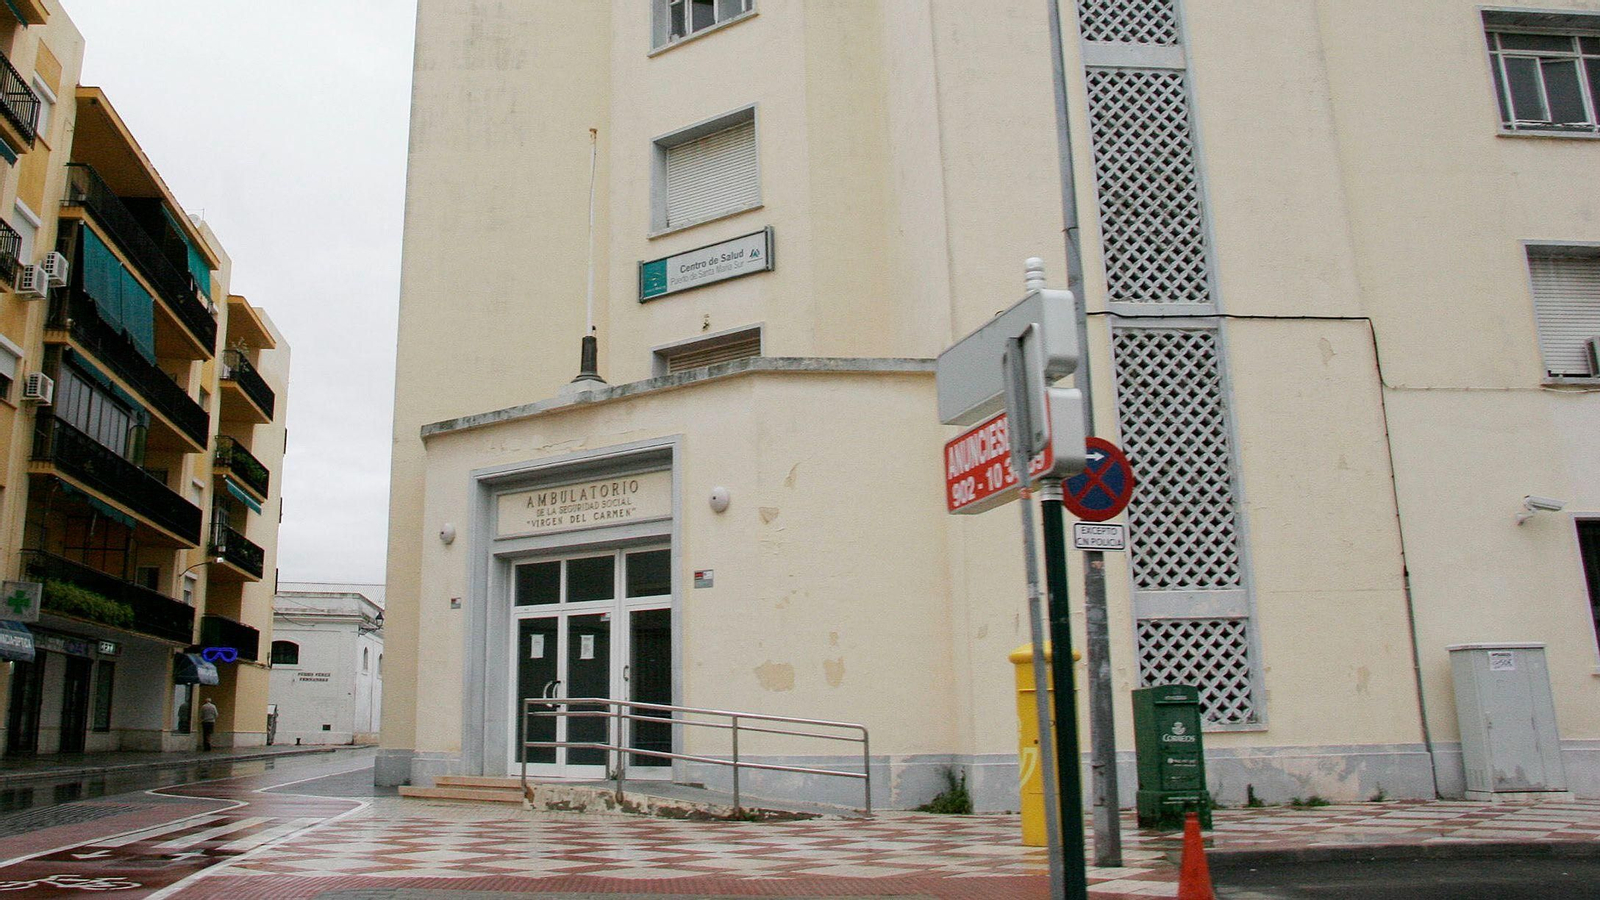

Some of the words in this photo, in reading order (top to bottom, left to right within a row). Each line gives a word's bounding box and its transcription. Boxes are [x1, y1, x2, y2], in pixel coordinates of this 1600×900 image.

[670, 275, 689, 286] Puerto
[690, 272, 697, 281] de
[697, 268, 715, 279] Santa
[734, 260, 744, 269] Sur
[680, 261, 707, 274] Centro
[709, 256, 719, 266] de
[721, 249, 744, 263] Salud
[526, 480, 639, 508] AMBULATORIO
[952, 476, 976, 507] 902
[986, 462, 1003, 491] 10
[536, 508, 545, 517] DE
[547, 507, 557, 516] LA
[559, 502, 600, 514] SEGURIDAD
[602, 497, 632, 509] SOCIAL
[570, 514, 587, 524] DEL
[1081, 526, 1118, 536] EXCEPTO
